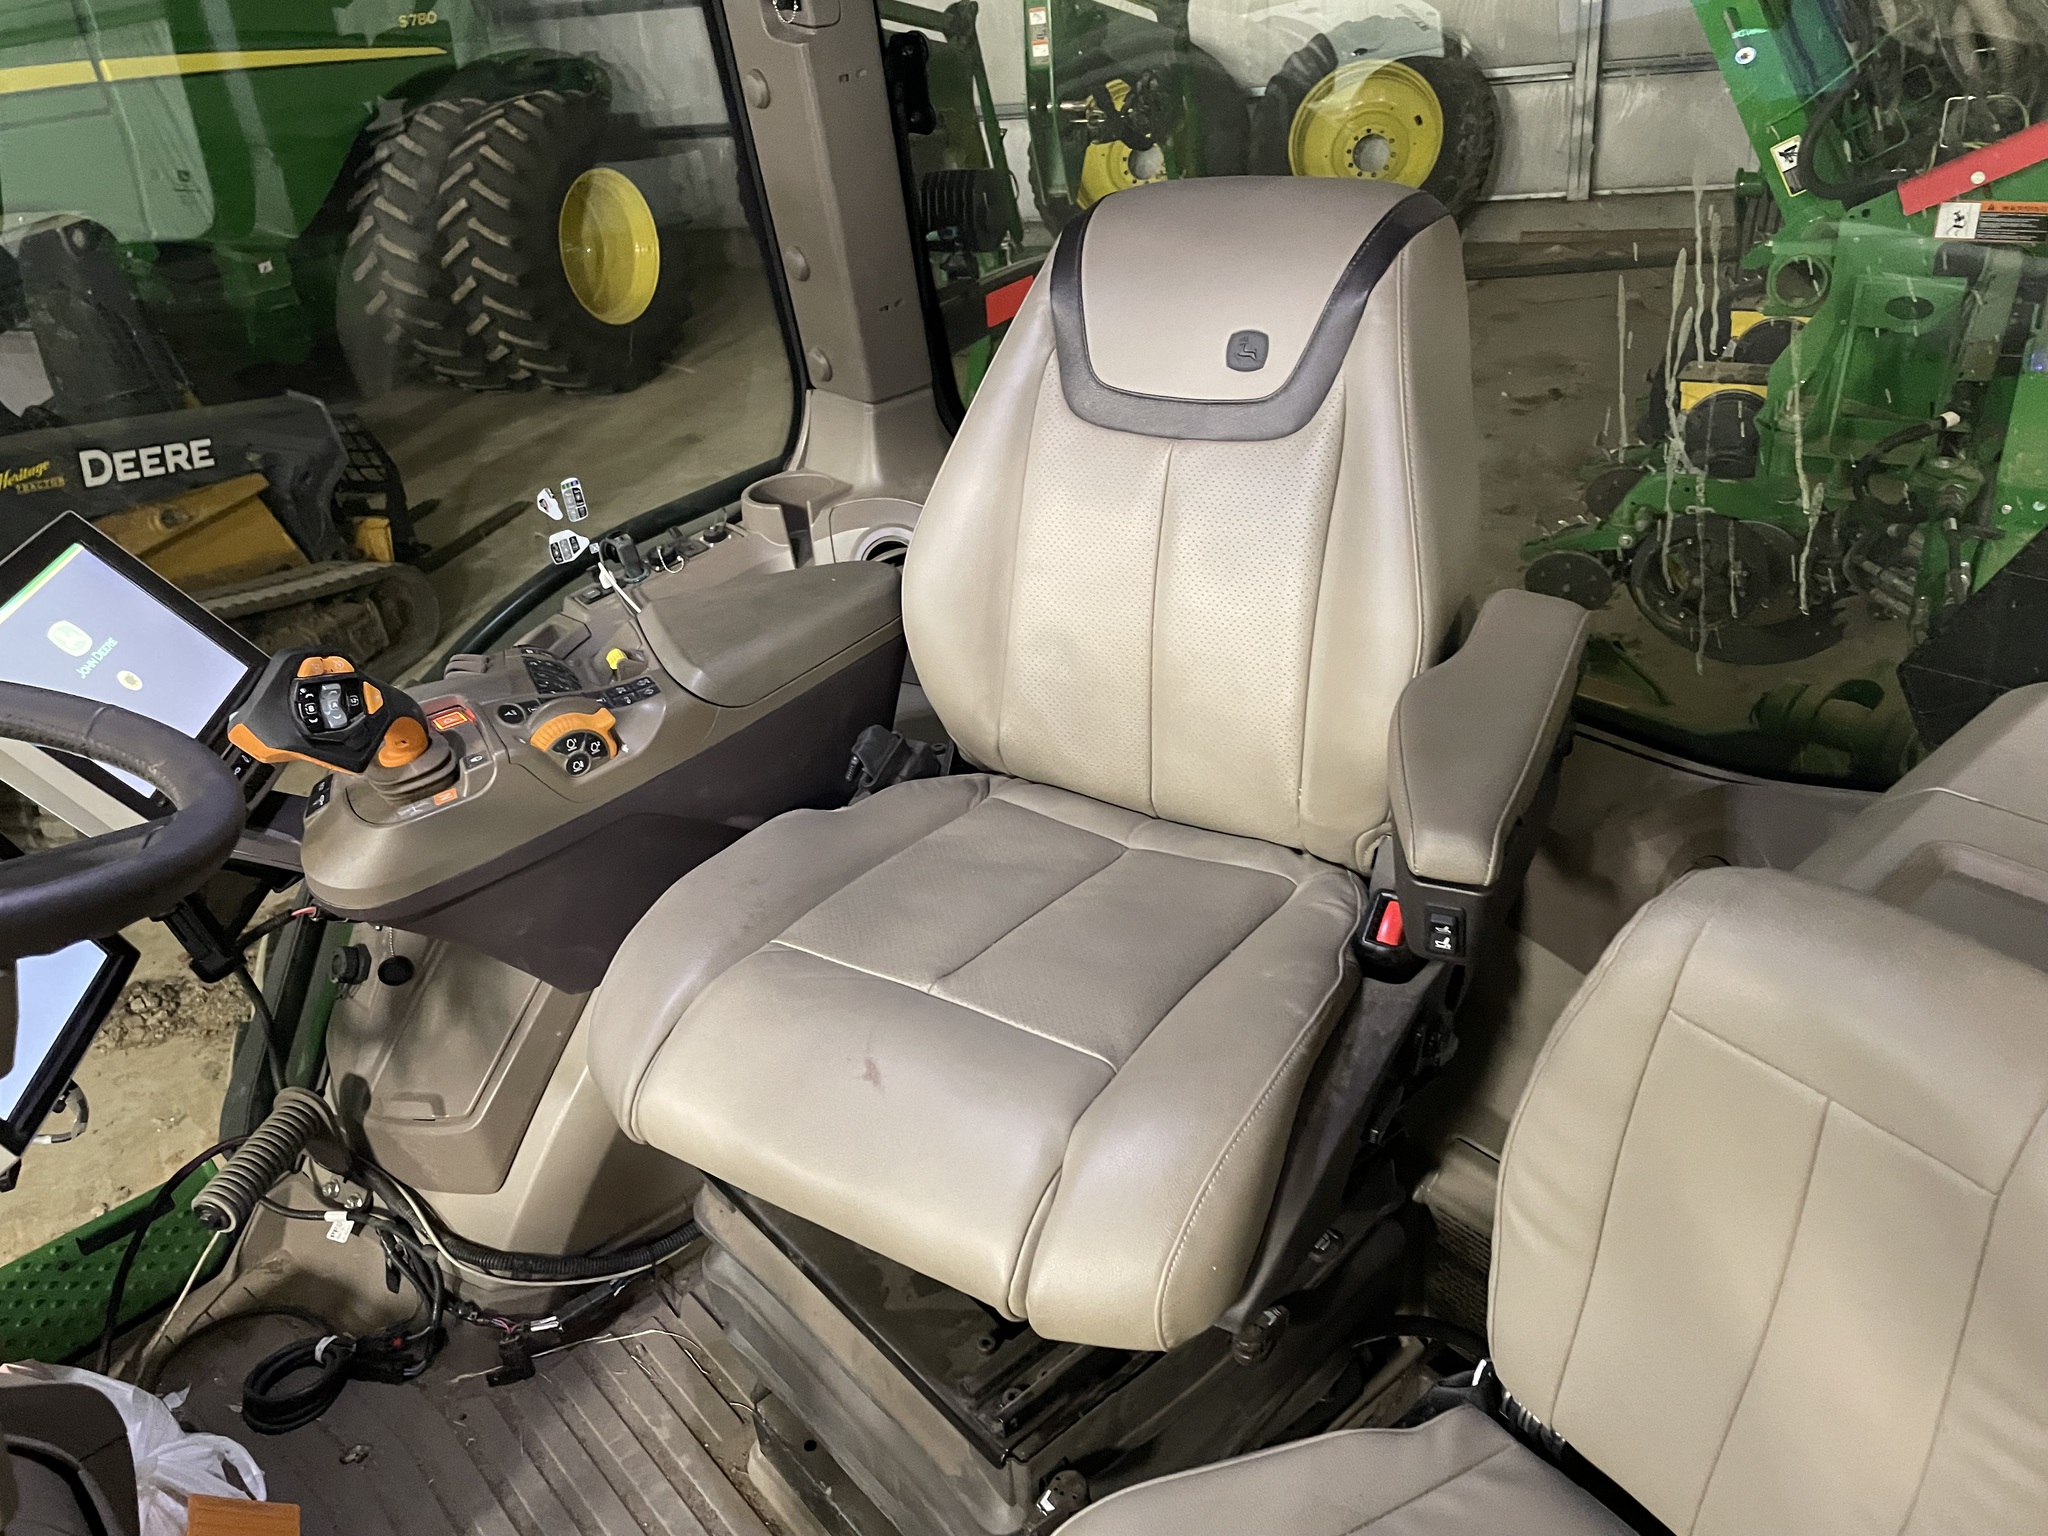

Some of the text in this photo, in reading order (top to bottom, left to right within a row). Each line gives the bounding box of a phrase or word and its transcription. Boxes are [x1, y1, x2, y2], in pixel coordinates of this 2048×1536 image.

[398, 10, 438, 28] S780
[79, 438, 215, 488] DEERE
[76, 637, 118, 679] JOHN DEERE
